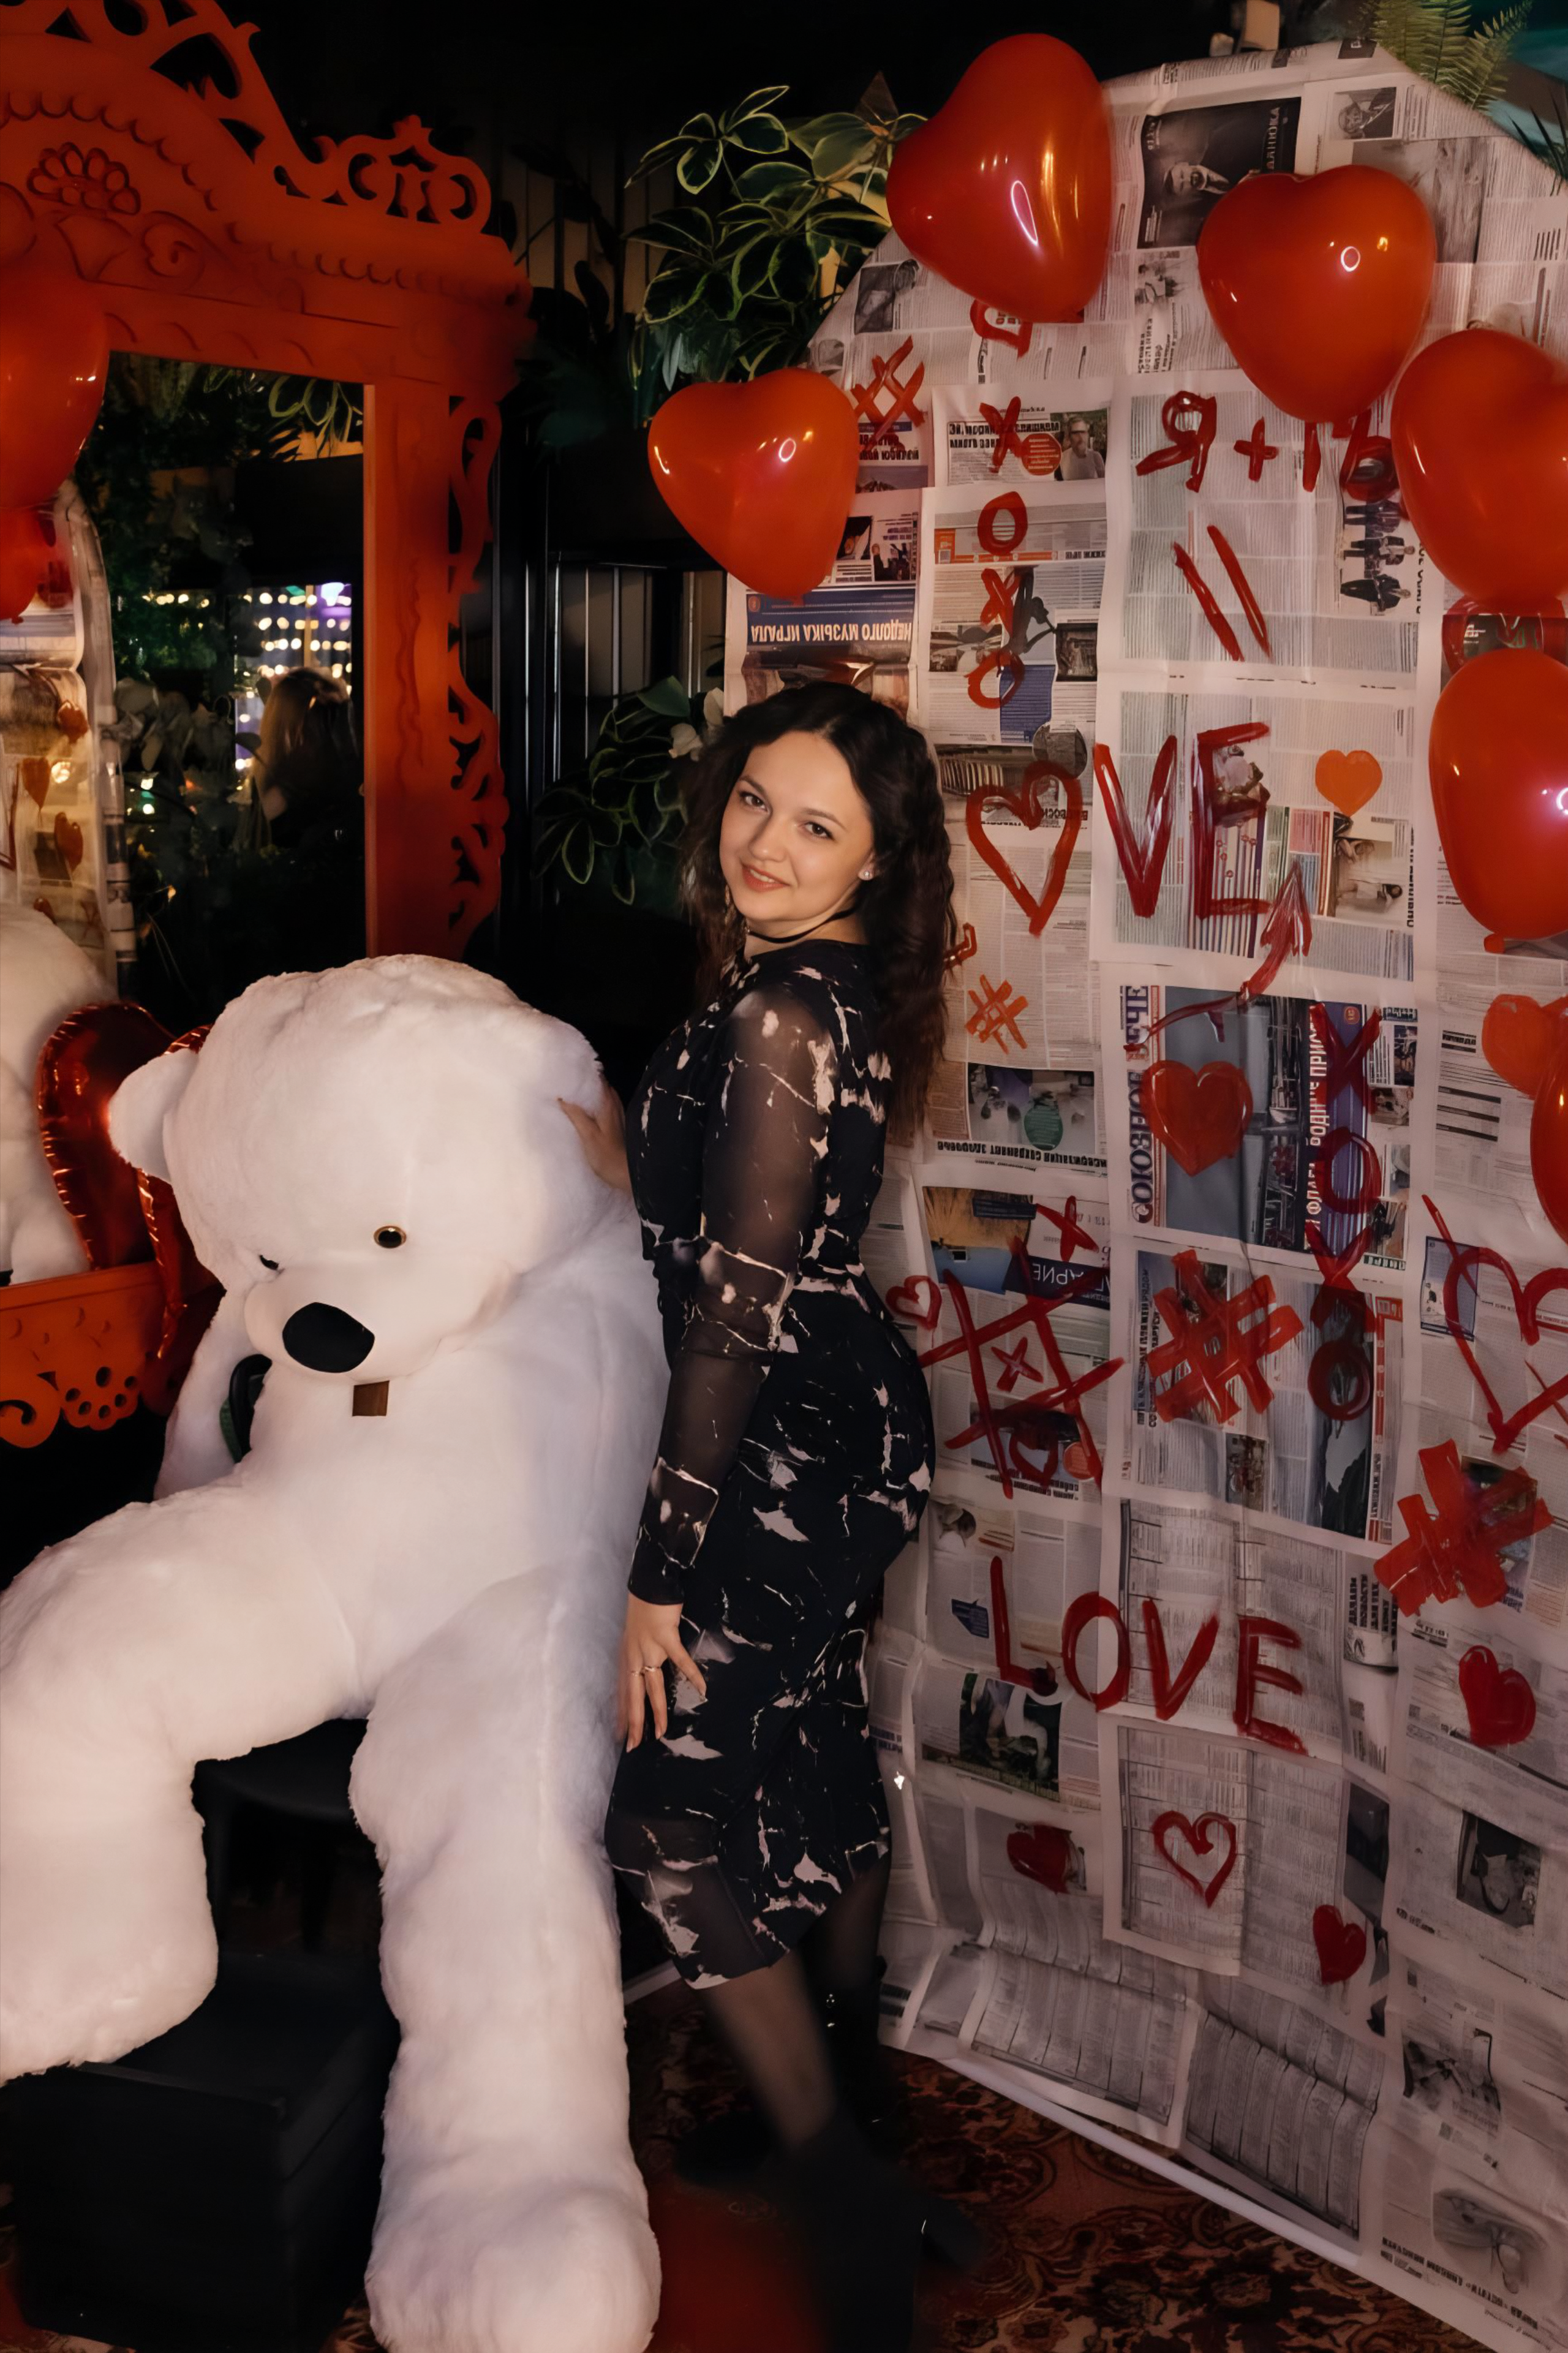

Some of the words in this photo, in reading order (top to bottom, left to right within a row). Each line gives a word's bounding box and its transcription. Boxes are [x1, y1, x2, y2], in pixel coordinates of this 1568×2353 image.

[1136, 390, 1216, 493] Я
[750, 624, 800, 643] ИГРАЛА
[803, 623, 859, 641] МУЗЫКА
[862, 619, 913, 641] НЕДОЛГО
[988, 1555, 1310, 1757] LOVE
